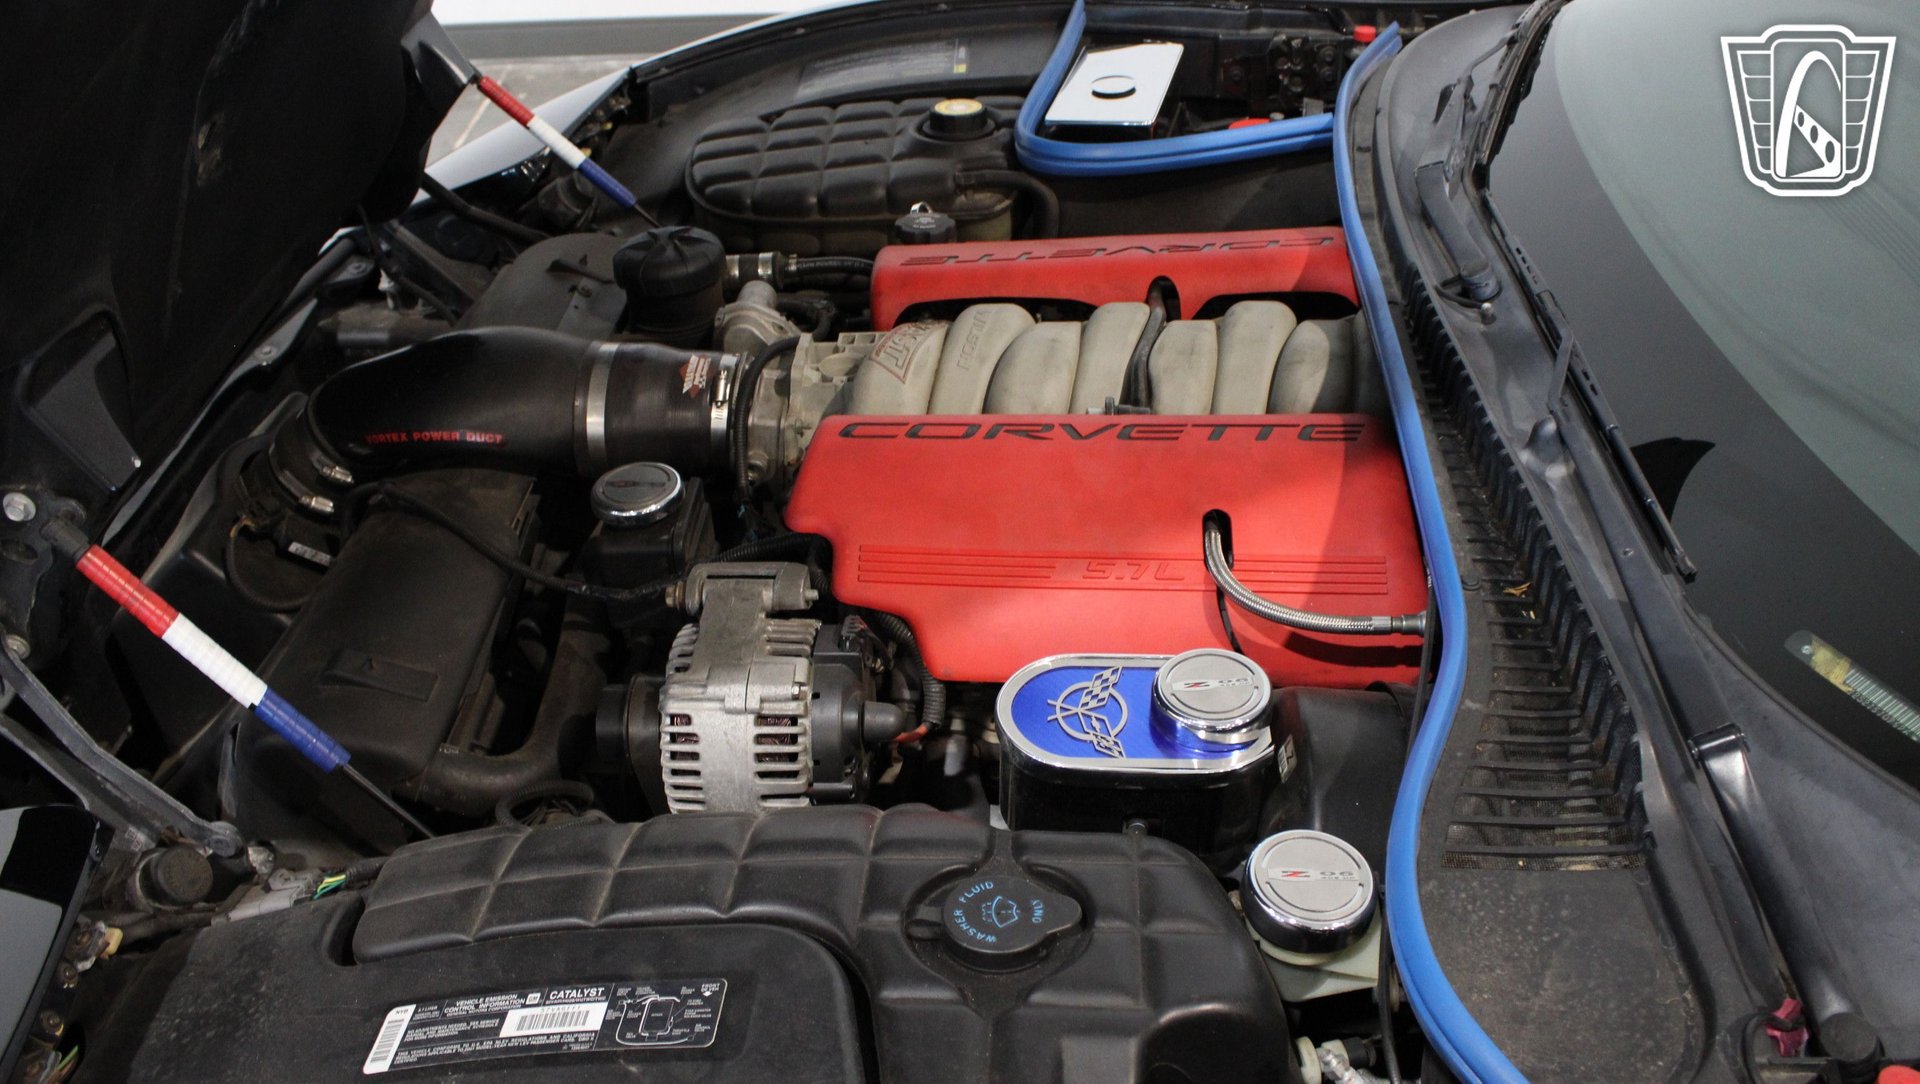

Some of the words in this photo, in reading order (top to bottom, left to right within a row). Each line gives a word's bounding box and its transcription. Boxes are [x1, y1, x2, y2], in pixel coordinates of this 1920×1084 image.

[901, 237, 1335, 266] CORVETTE
[367, 431, 408, 444] VORTEX
[412, 431, 460, 442] POWER
[466, 431, 503, 443] DUCT
[838, 421, 1366, 442] CORVETTE
[1082, 560, 1186, 581] 5.7L
[958, 881, 994, 904] FLUID
[1031, 899, 1044, 924] ONLY
[953, 908, 998, 943] WASHER
[456, 998, 484, 1007] VEHICLE
[485, 993, 518, 1003] EMISSION
[550, 987, 605, 1000] CATALYST
[444, 1005, 476, 1014] CONTROL
[478, 998, 526, 1010] INFORMATION
